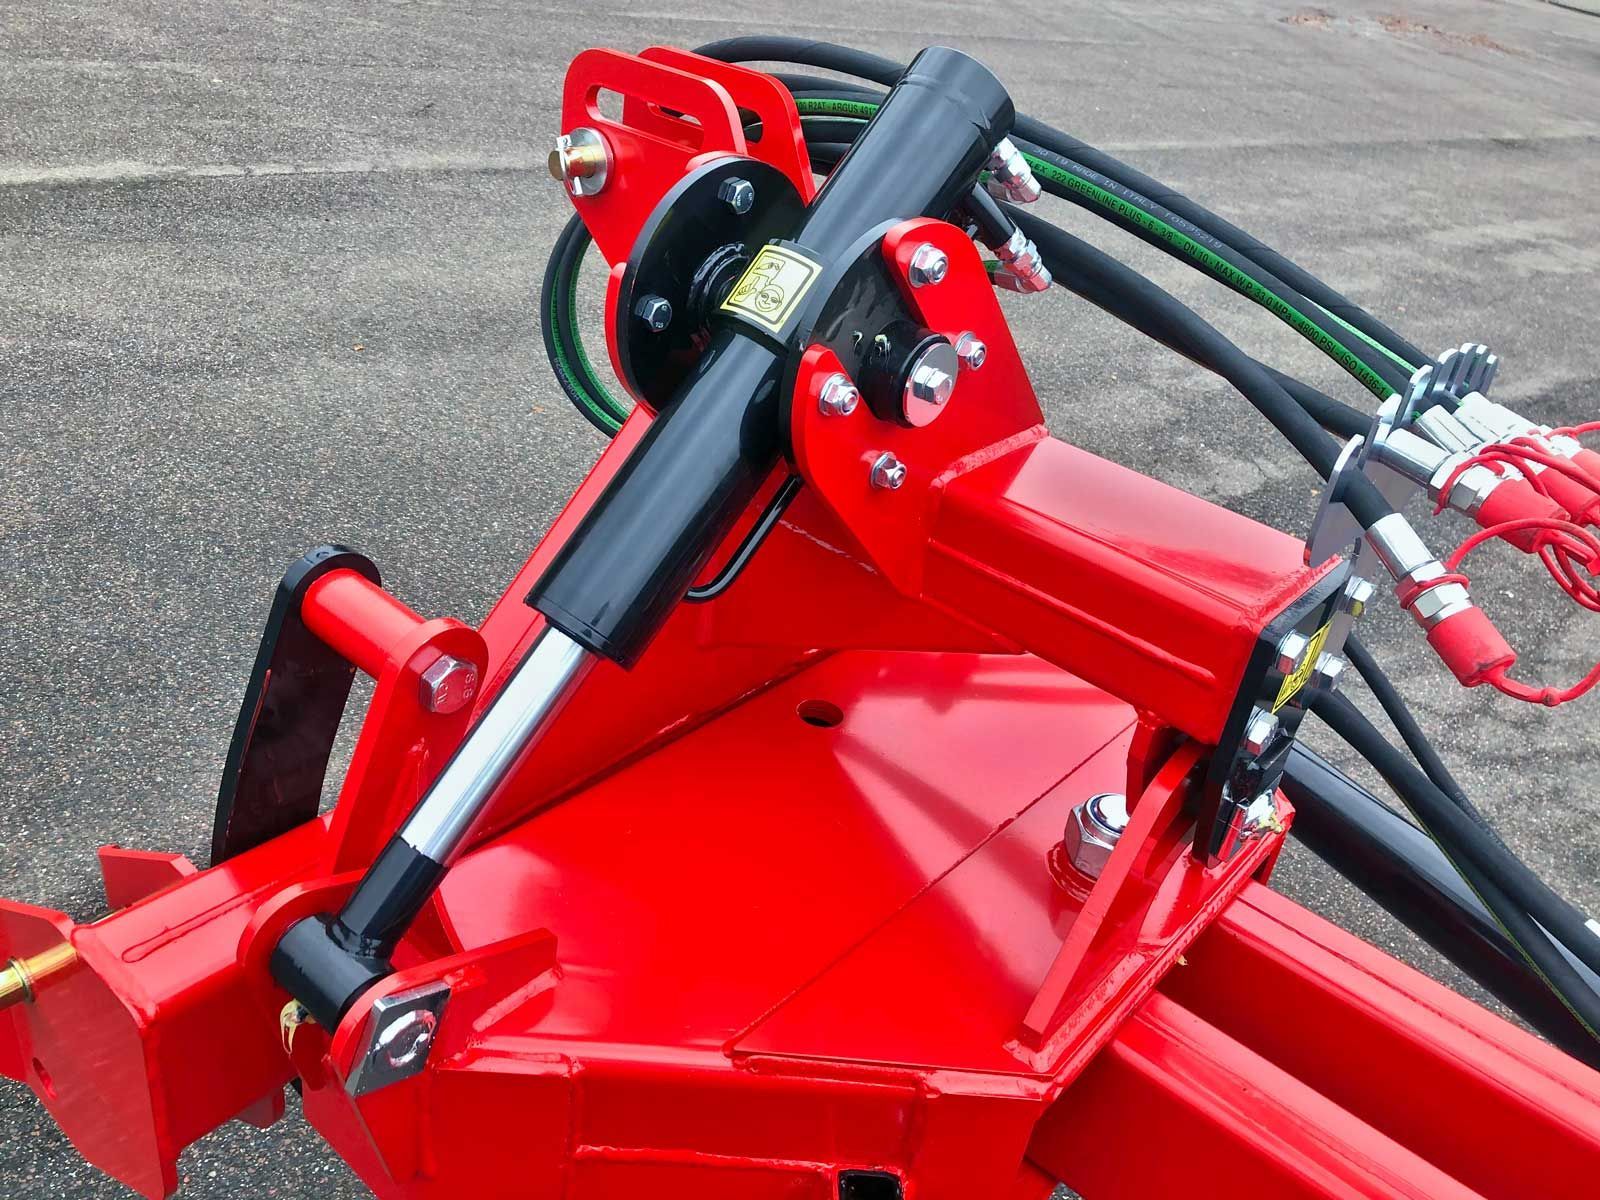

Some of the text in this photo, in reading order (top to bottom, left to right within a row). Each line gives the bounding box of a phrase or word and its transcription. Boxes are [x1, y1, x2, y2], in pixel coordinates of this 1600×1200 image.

[832, 102, 858, 113] ARGUS
[1123, 190, 1159, 209] ITALY
[1051, 170, 1066, 183] 222
[1067, 178, 1118, 209] GREENLINE
[1118, 203, 1142, 223] PLUS
[1147, 220, 1154, 231] 6
[1183, 241, 1198, 256] DN
[1199, 251, 1209, 262] 10
[1214, 261, 1236, 279] MAX
[1273, 301, 1292, 320] MPa
[1298, 320, 1320, 341] 4800
[1320, 335, 1336, 353] PSI
[1340, 352, 1357, 370] ISO
[1359, 368, 1387, 394] 1436-1
